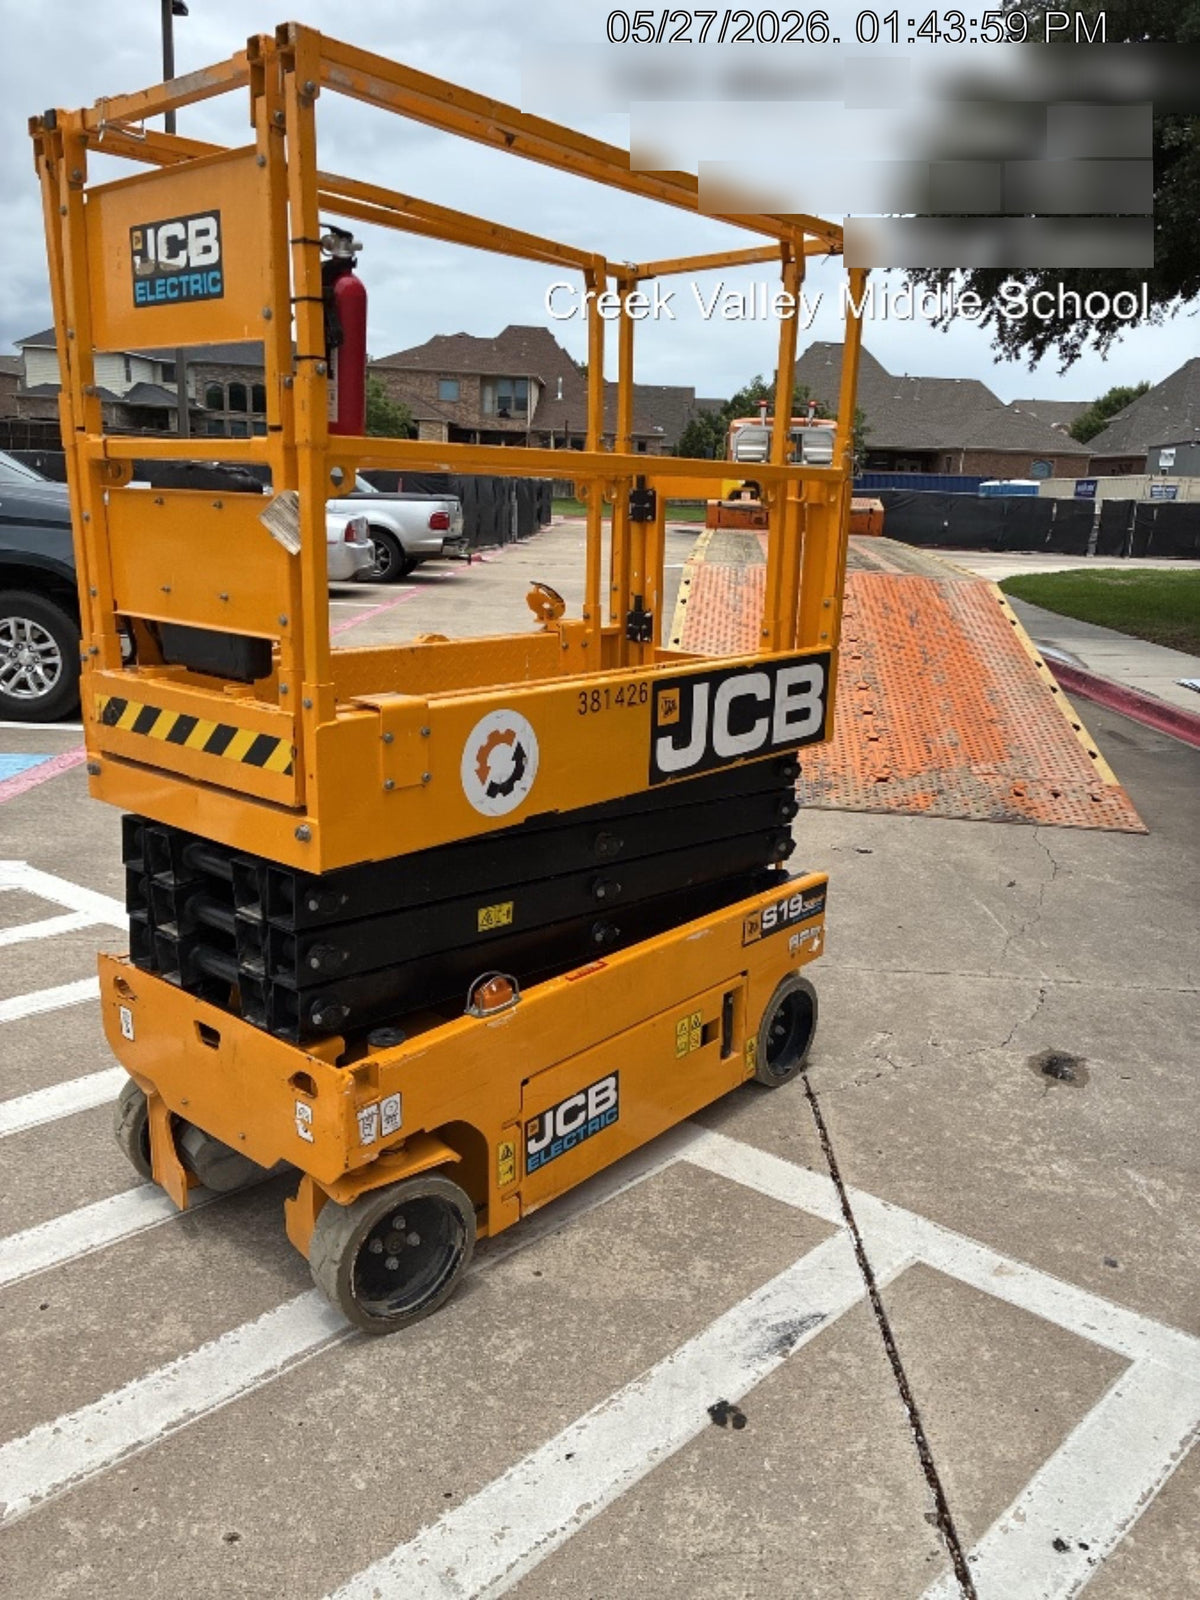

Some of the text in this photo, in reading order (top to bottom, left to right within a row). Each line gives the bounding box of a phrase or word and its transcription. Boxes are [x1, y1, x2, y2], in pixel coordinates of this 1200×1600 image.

[134, 216, 219, 276] JCB
[135, 271, 222, 303] ELECTRIC
[578, 682, 649, 716] 381426
[656, 662, 825, 773] JCB
[527, 1075, 619, 1155] JCB
[527, 1106, 618, 1172] ELECTRIC
